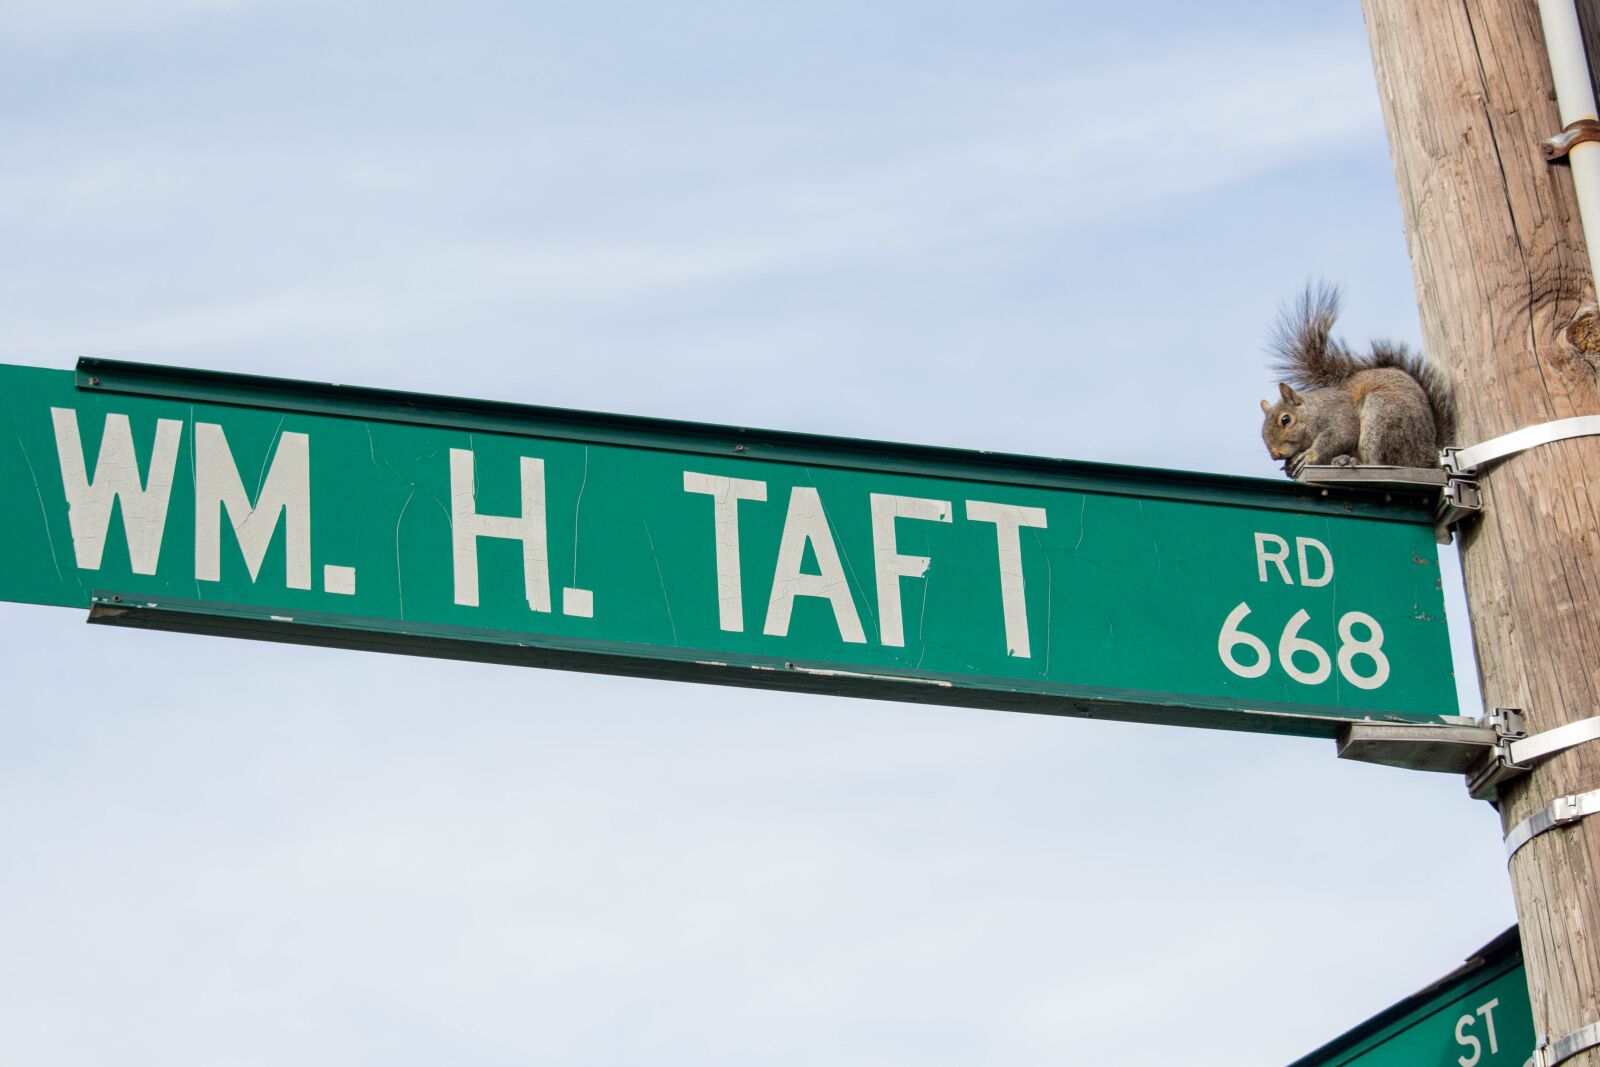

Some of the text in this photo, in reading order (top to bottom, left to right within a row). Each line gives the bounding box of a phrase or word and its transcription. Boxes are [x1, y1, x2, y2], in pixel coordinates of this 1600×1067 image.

[51, 407, 1048, 659] WM. H. TAFT
[1254, 532, 1334, 588] RD
[1218, 602, 1390, 690] 668
[1455, 998, 1499, 1067] ST
